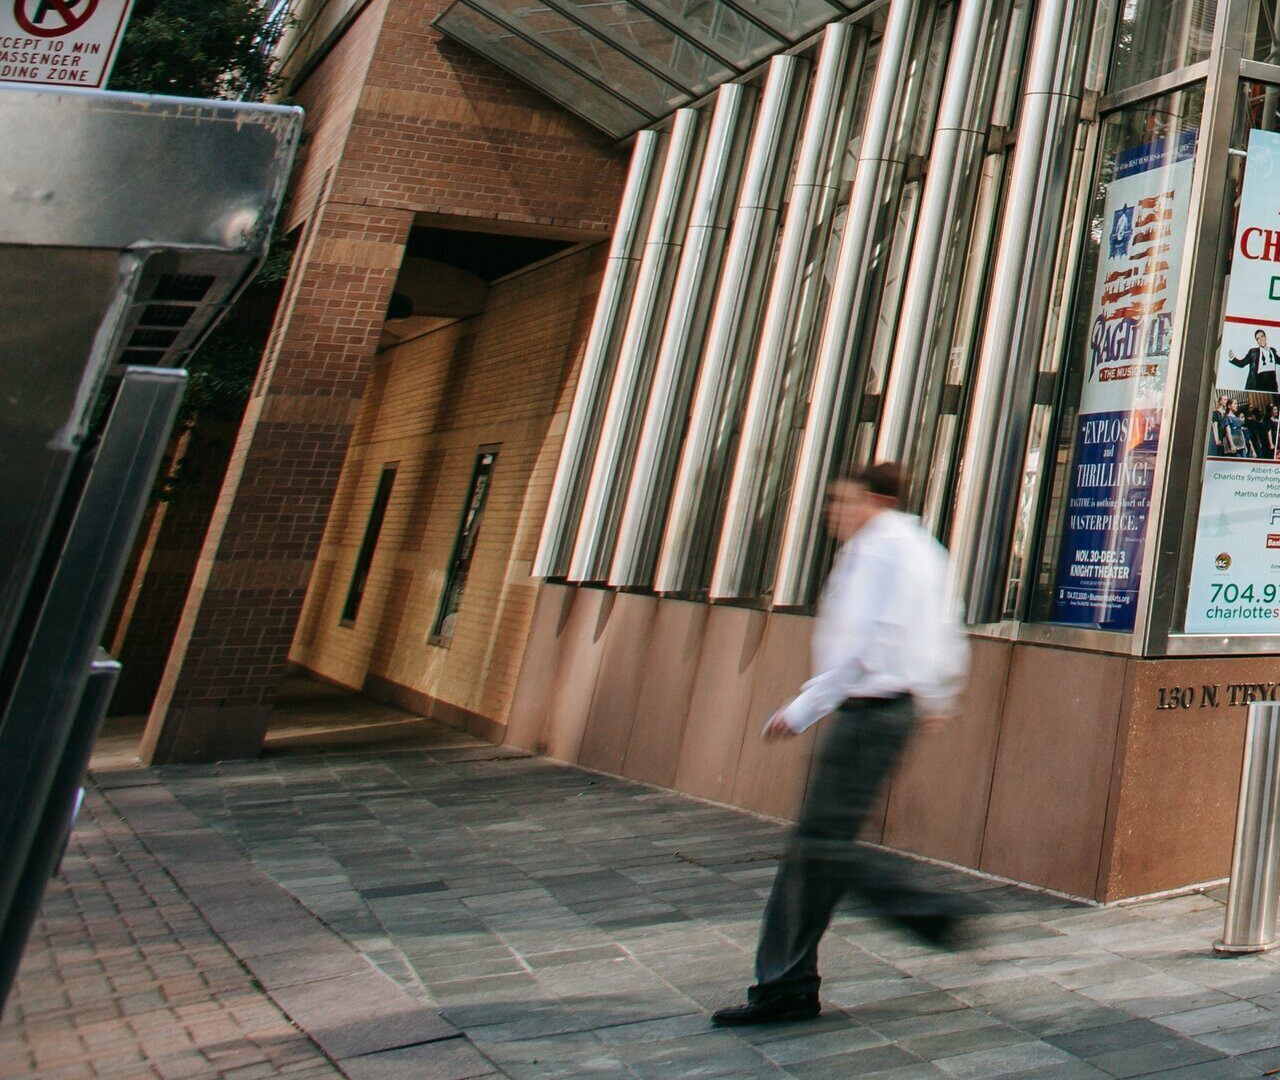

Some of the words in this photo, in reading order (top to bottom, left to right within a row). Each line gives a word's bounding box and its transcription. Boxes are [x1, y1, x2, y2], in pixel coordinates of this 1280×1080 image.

[48, 40, 64, 52] 10
[72, 42, 101, 54] MIN
[0, 66, 40, 79] DING
[47, 69, 89, 82] ZONE
[1103, 369, 1116, 379] THE
[1102, 444, 1114, 458] and
[1077, 461, 1148, 488] THRILLING!
[1213, 472, 1246, 481] Charlotte
[1247, 474, 1280, 484] Symphony
[1234, 490, 1258, 498] Martha
[1137, 496, 1145, 508] of
[1075, 549, 1089, 562] NOV.
[1090, 550, 1118, 563] 30-DEC.
[1119, 550, 1126, 564] 3
[1070, 564, 1093, 578] KNIGHT
[1094, 565, 1130, 579] THEATER
[1200, 683, 1220, 709] N.
